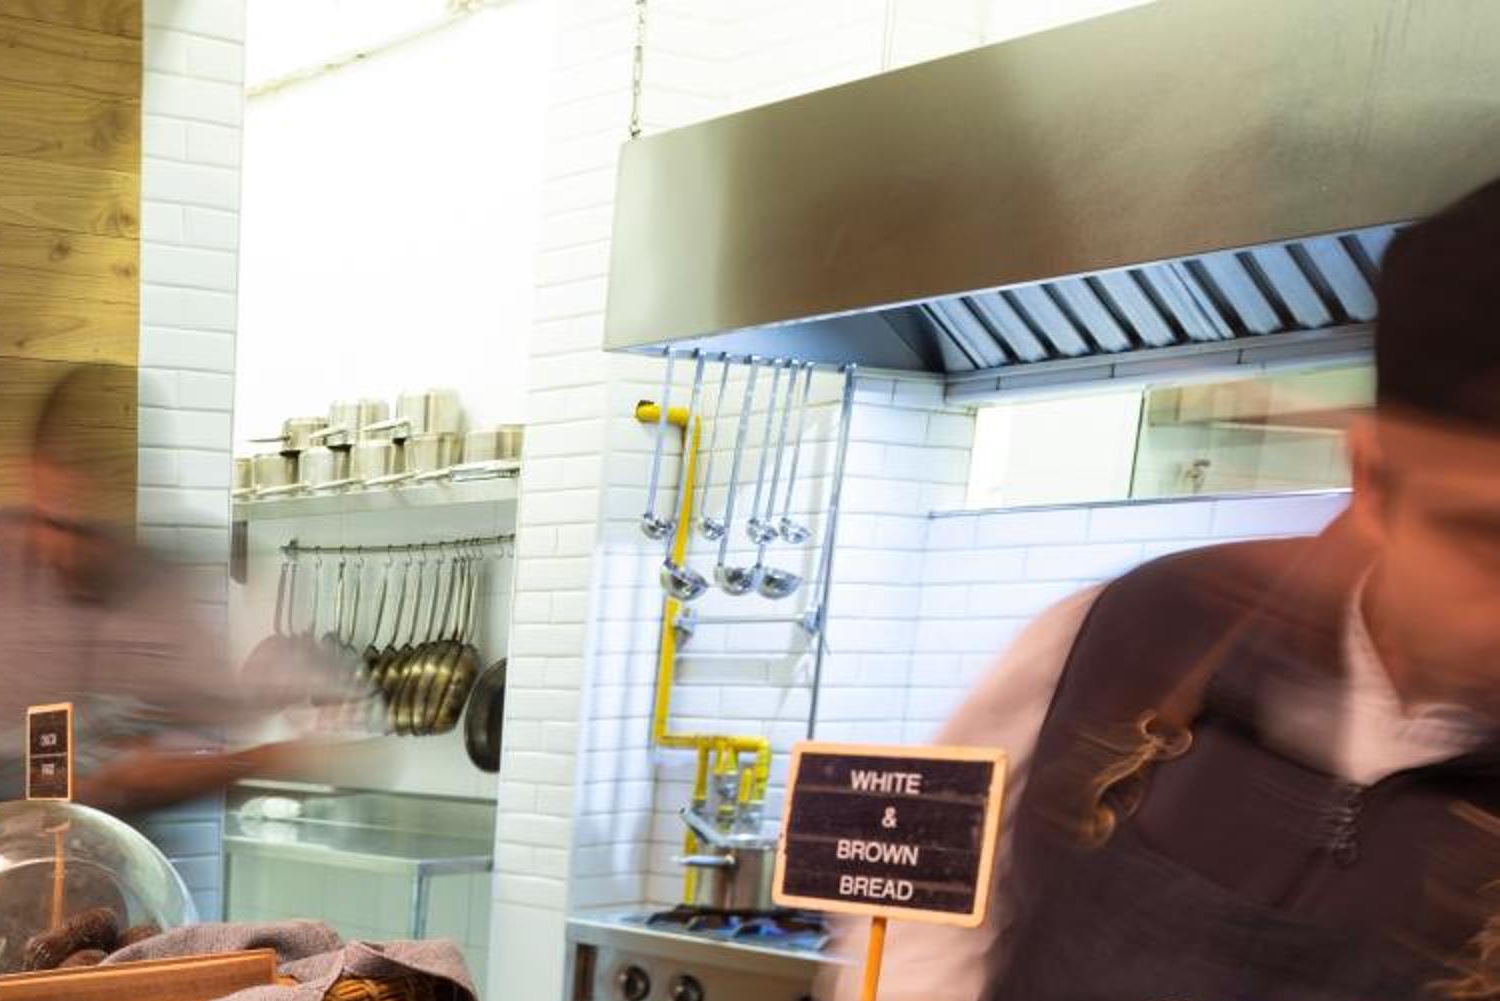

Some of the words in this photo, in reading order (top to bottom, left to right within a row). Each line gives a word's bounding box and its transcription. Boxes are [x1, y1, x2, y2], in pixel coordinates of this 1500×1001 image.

[851, 770, 922, 795] WHITE
[882, 807, 897, 828] &
[836, 839, 919, 866] BROWN
[840, 875, 913, 901] BREAD
